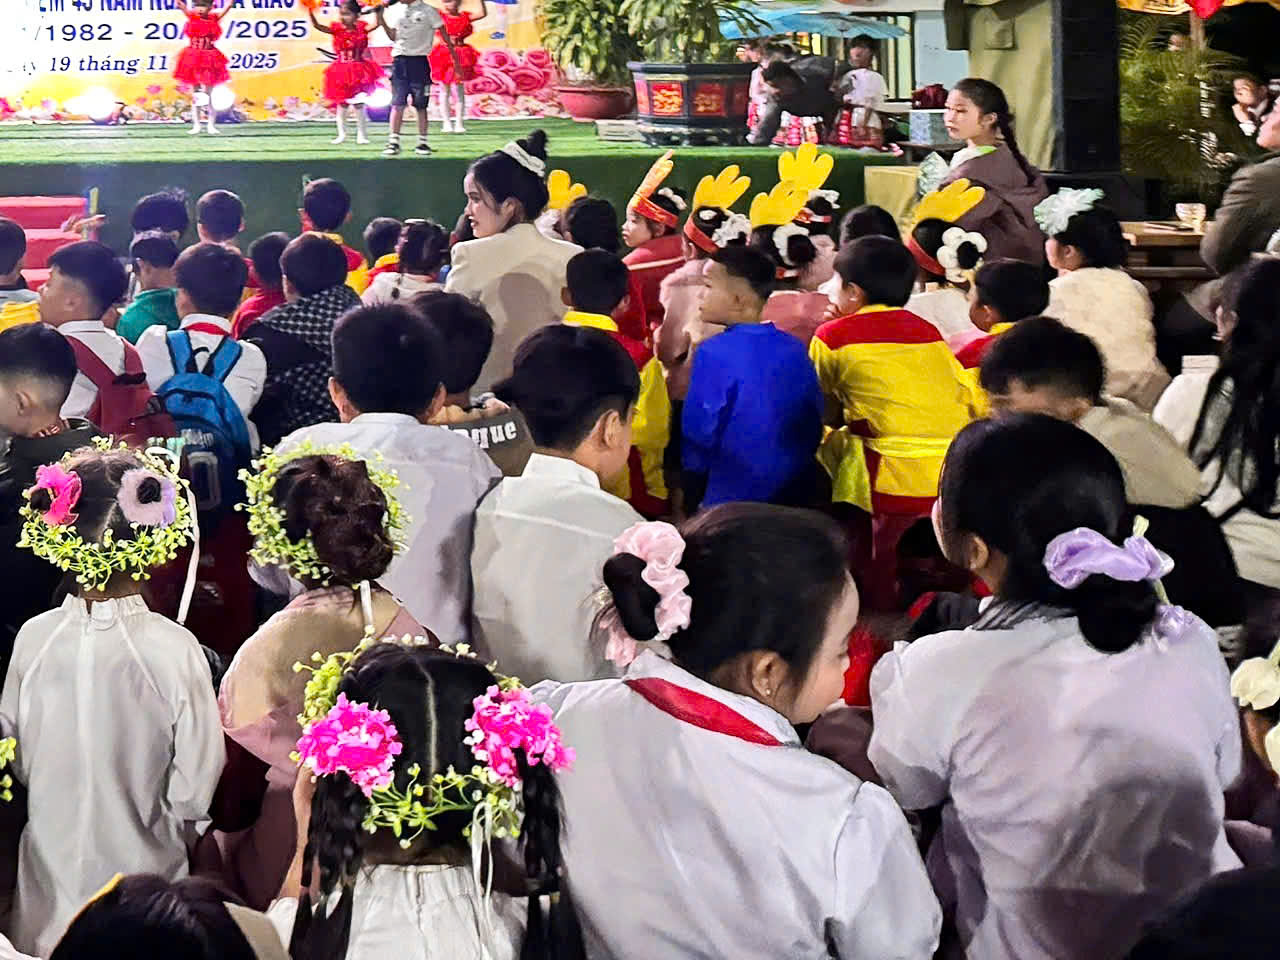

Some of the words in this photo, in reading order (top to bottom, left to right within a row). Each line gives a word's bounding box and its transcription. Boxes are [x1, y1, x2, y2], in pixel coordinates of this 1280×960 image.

[49, 56, 71, 72] 19
[78, 55, 140, 75] tháng
[146, 55, 168, 71] 11
[230, 52, 278, 70] 2025
